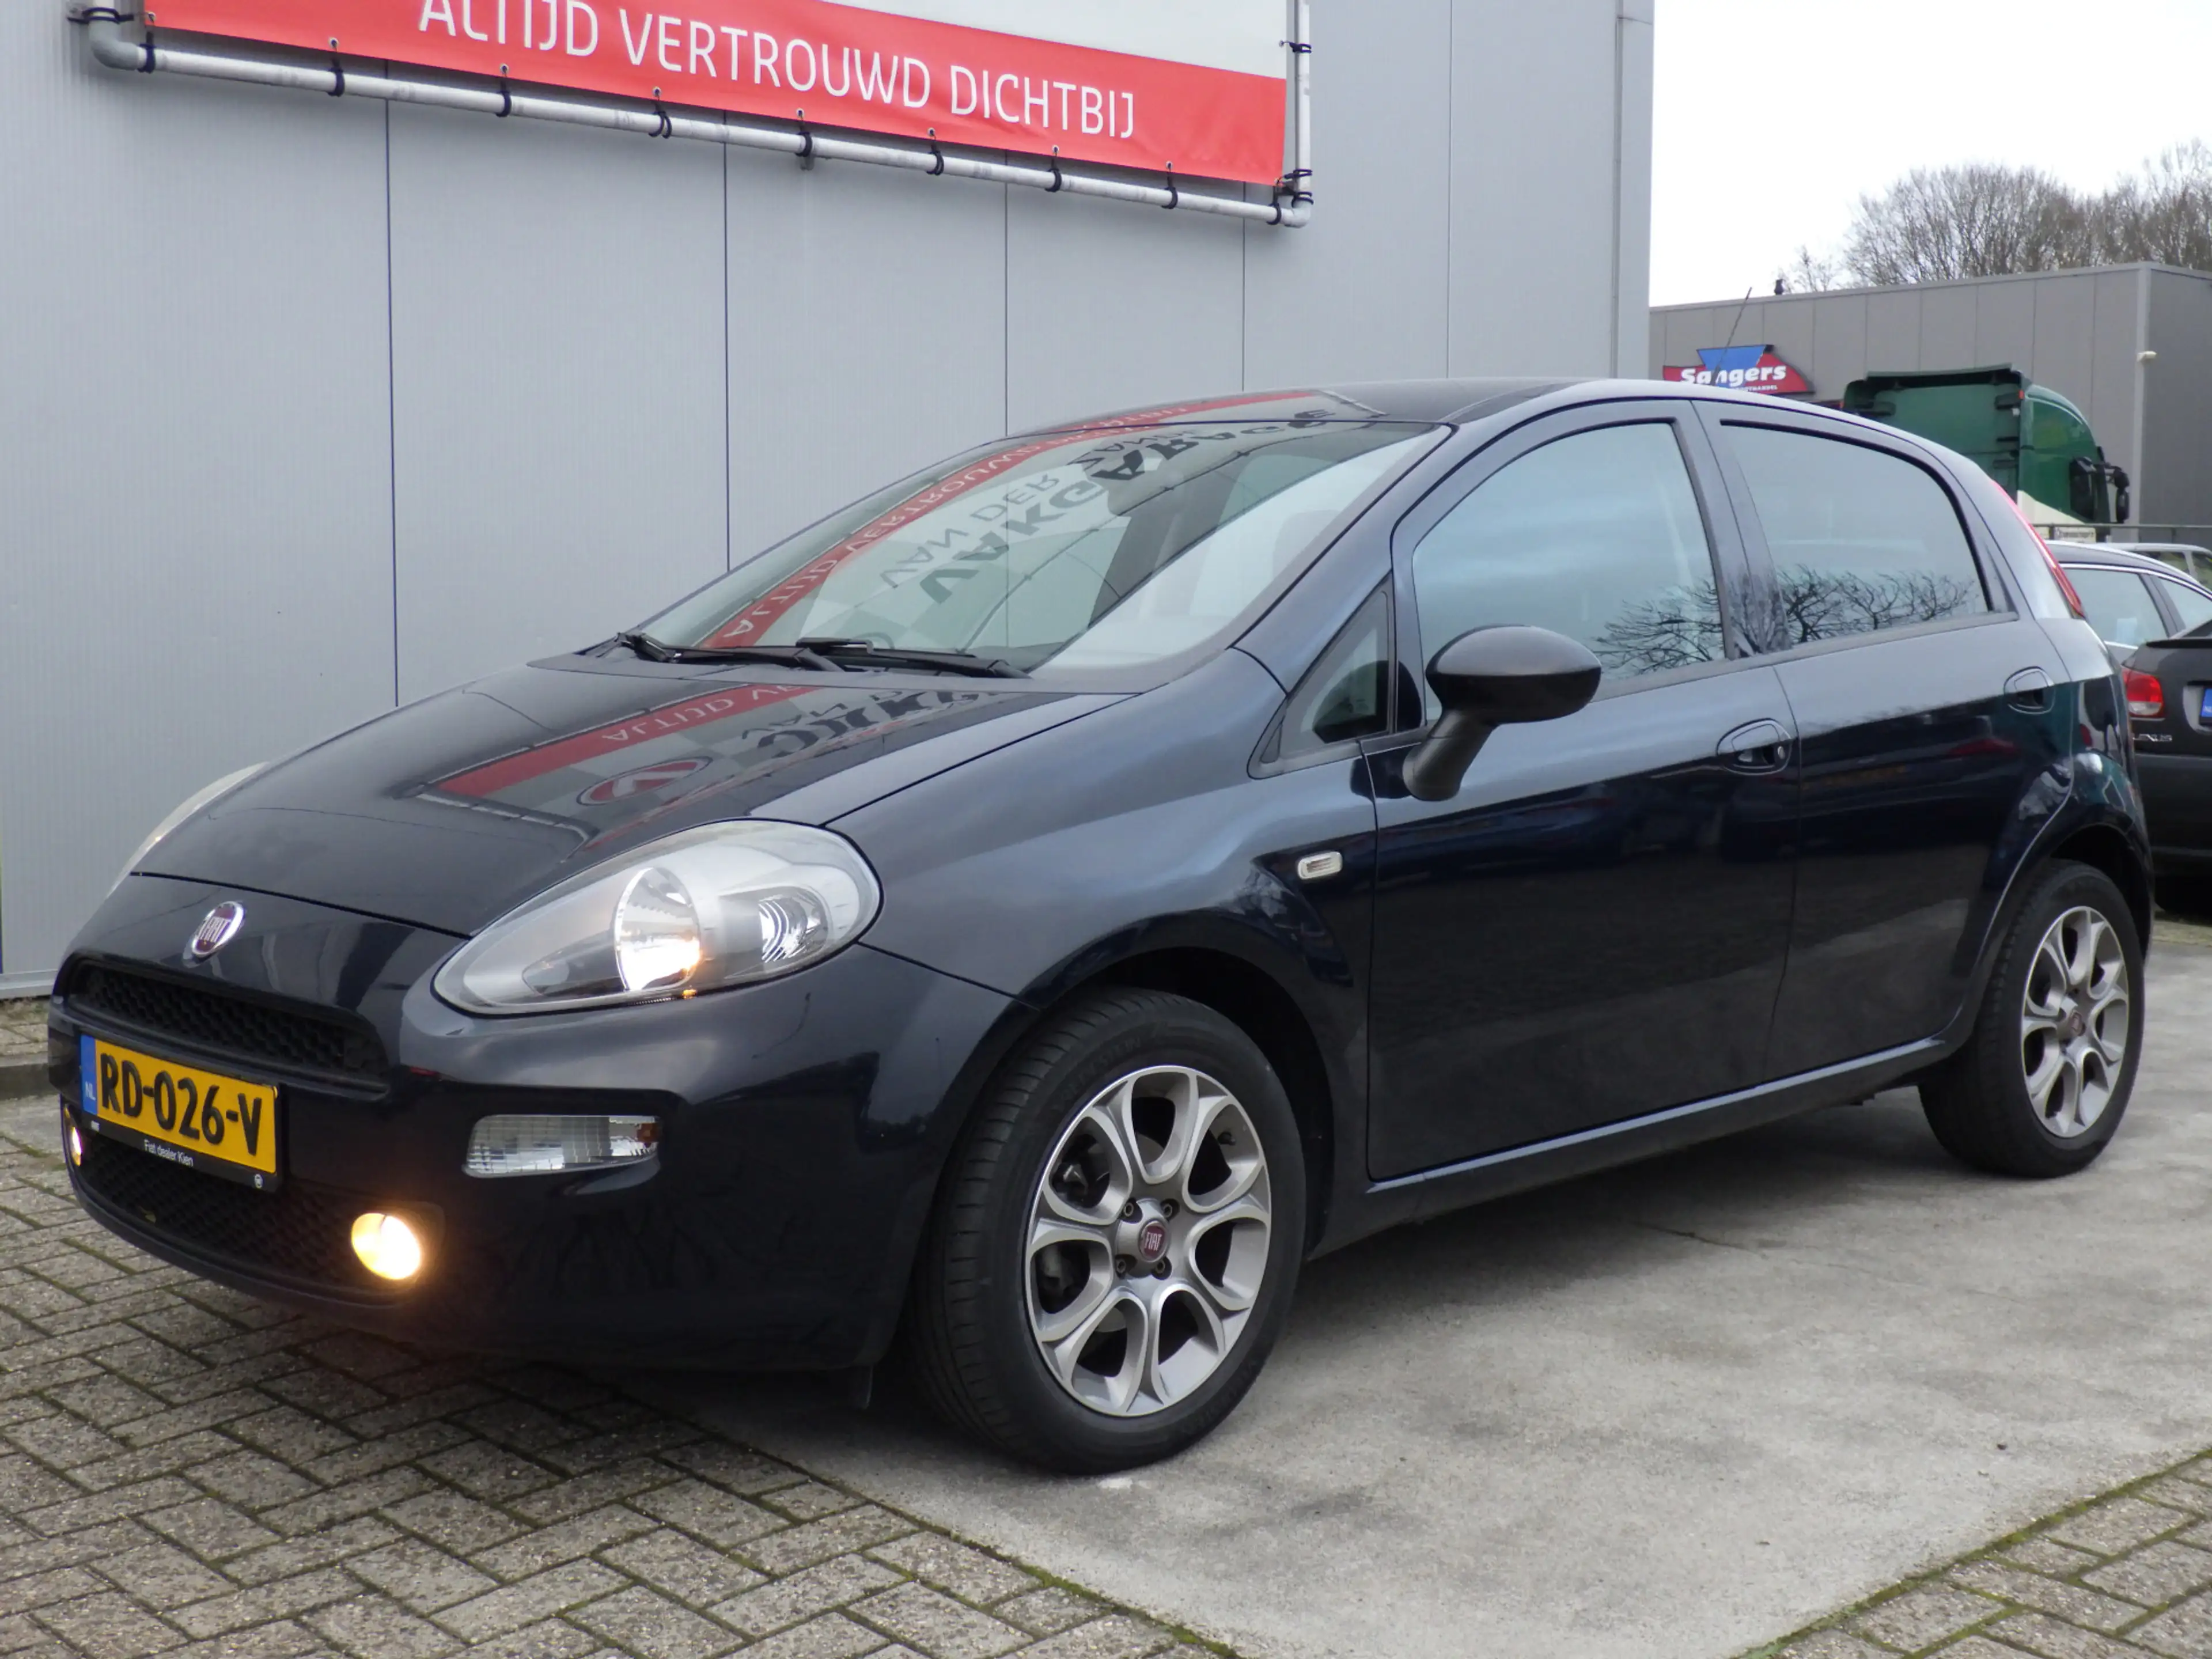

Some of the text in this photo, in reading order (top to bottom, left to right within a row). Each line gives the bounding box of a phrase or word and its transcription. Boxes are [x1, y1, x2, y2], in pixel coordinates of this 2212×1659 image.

[419, 0, 1134, 139] ALTIJD VERTROUWD DICHTBIJ
[1680, 365, 1787, 388] Sangers
[85, 1081, 97, 1101] NL
[100, 1052, 262, 1156] RD-026-V
[144, 1139, 156, 1154] Fiat
[157, 1145, 177, 1161] dealer
[1144, 1231, 1162, 1251] FIAT
